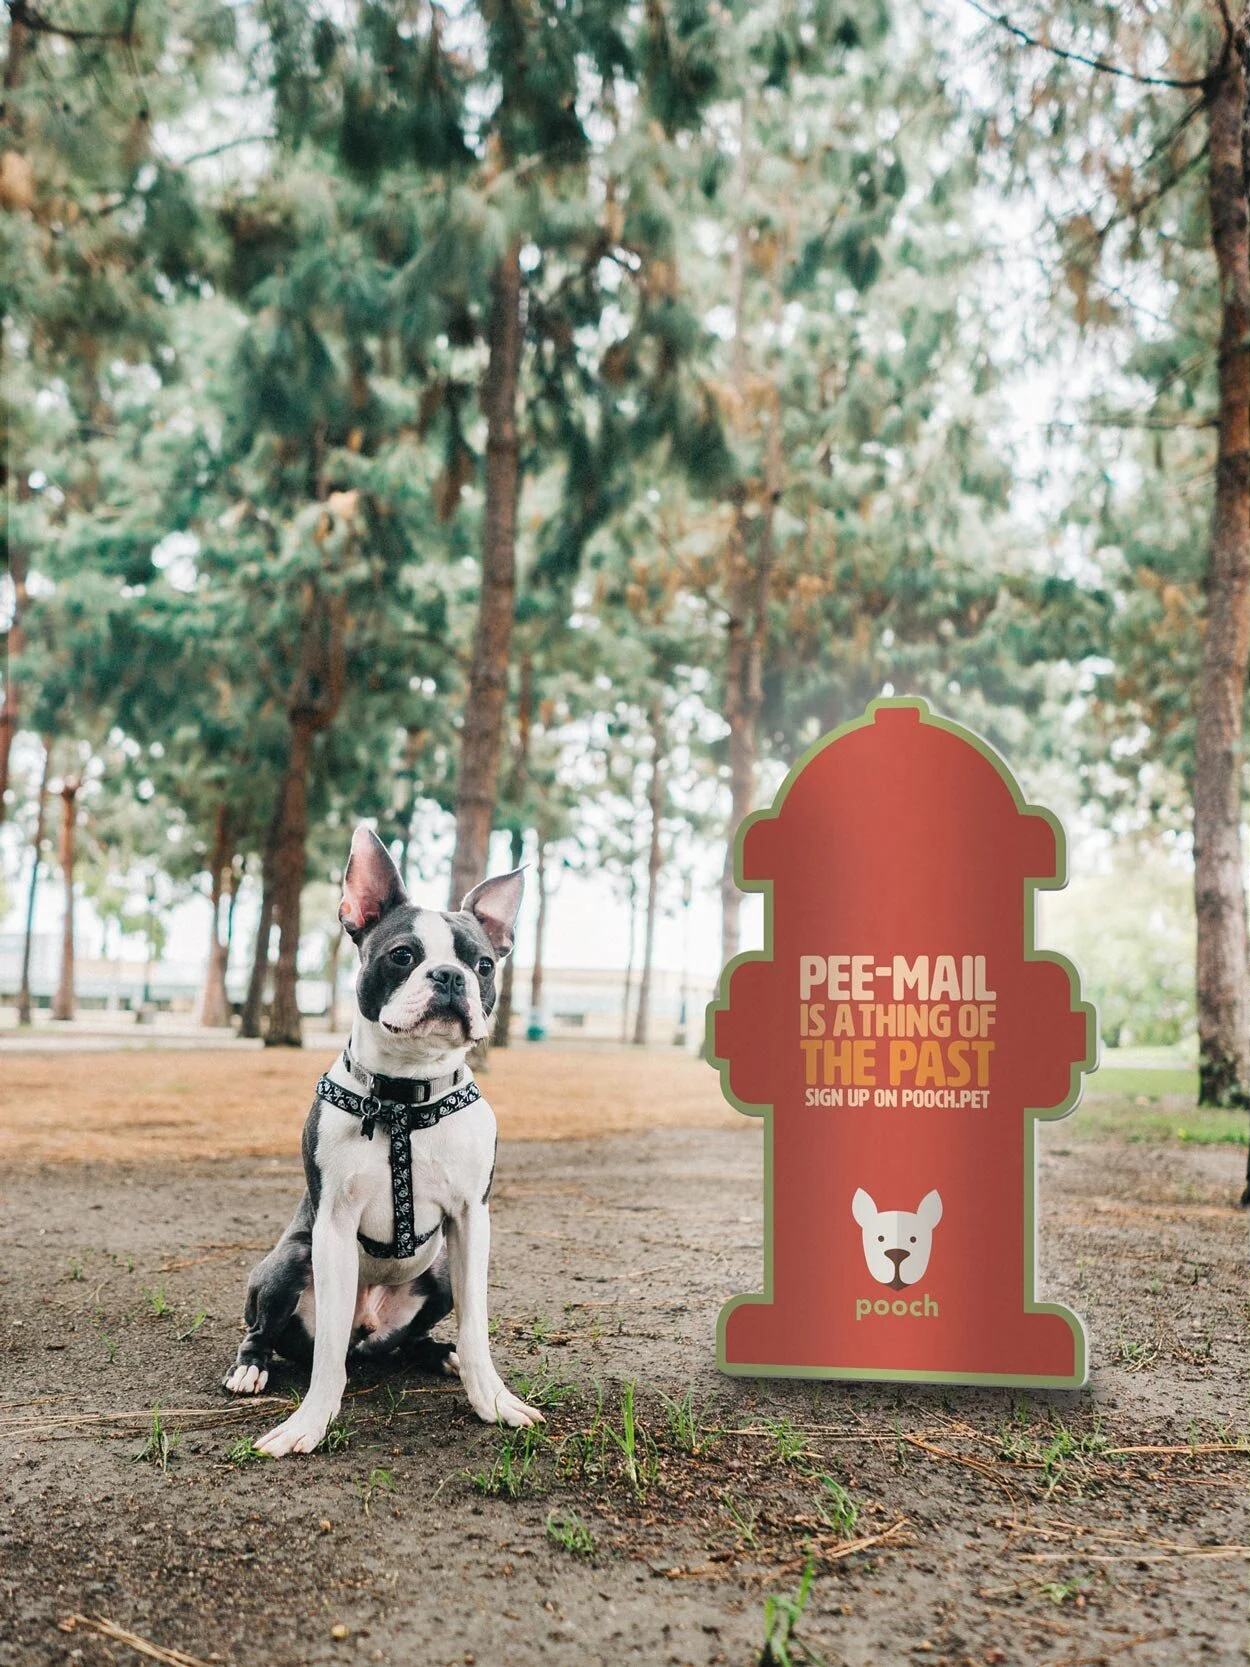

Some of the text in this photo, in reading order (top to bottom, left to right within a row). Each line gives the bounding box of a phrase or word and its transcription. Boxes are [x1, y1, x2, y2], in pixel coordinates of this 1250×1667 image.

[800, 955, 997, 1001] PEE-MAIL
[800, 1004, 996, 1038] IS A THING OF
[800, 1040, 995, 1087] THE PAST
[805, 1088, 990, 1109] SIGN UP ON POOCH.PET
[856, 1294, 939, 1320] pooch
